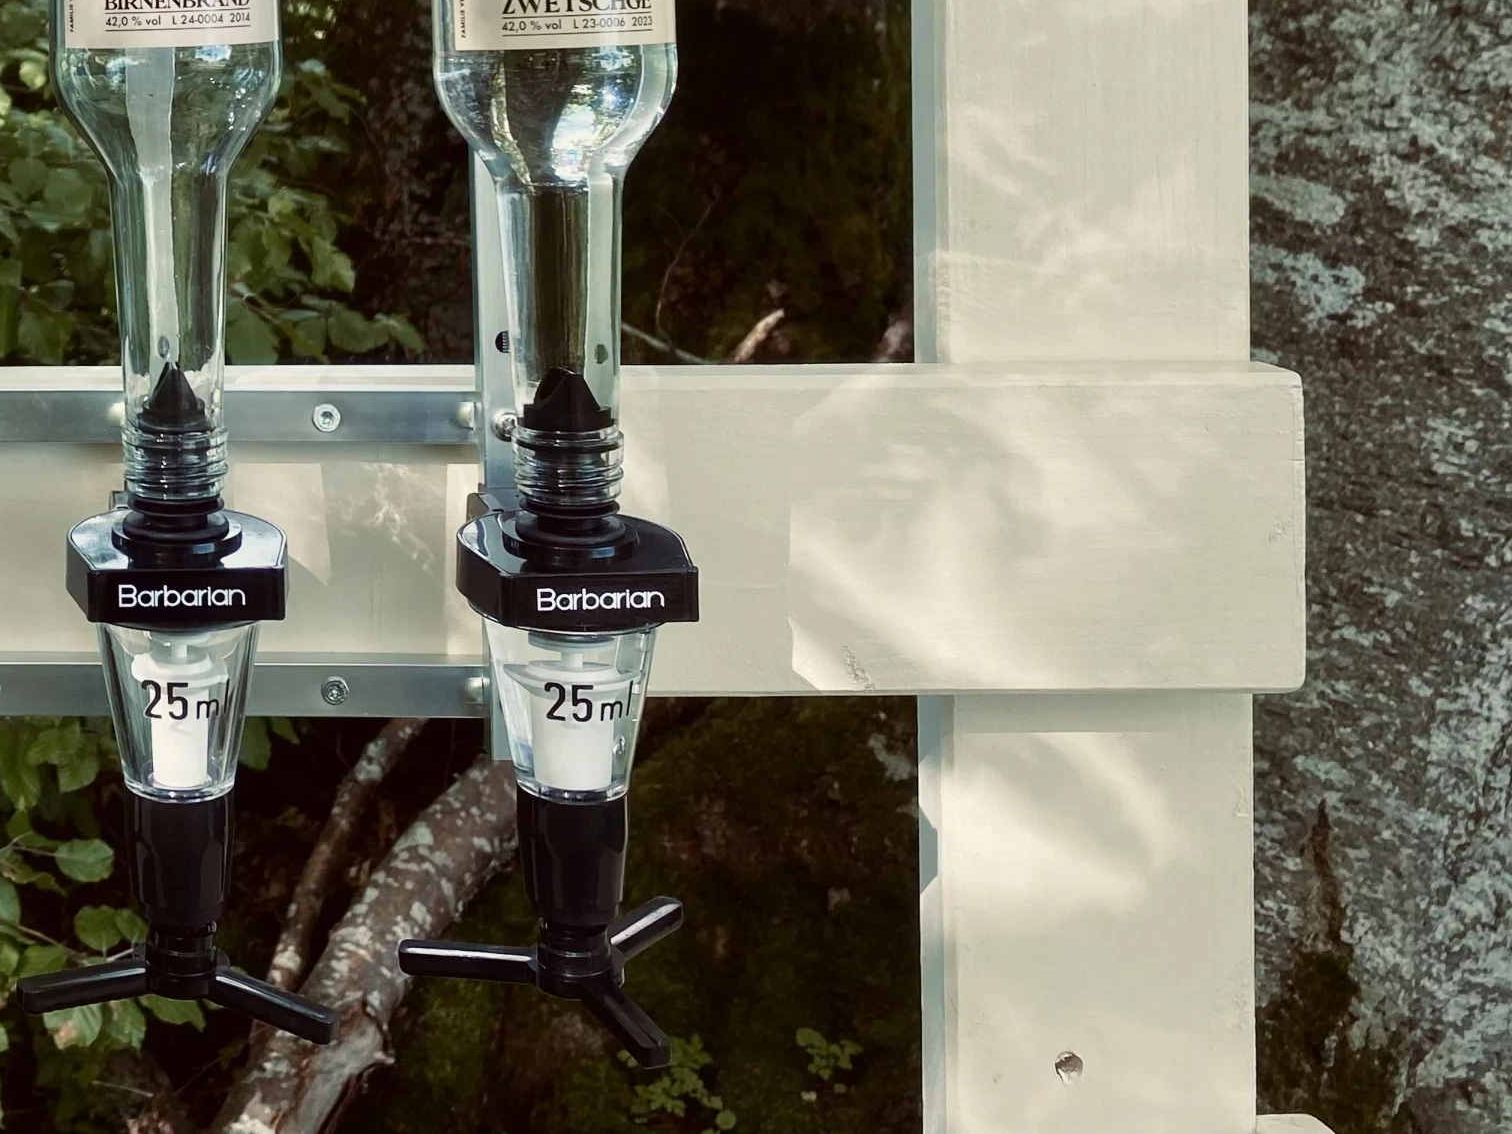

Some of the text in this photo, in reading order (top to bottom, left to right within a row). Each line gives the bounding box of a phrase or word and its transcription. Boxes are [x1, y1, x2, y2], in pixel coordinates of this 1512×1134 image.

[105, 12, 250, 29] 42,0 % vol L 24-0004 2014
[502, 16, 653, 33] 42,0 % vol L 23-0006 2023
[117, 583, 246, 609] Barbarian
[536, 587, 665, 612] Barbarian
[141, 680, 230, 721] 25 ml
[544, 682, 635, 723] 25 ml
